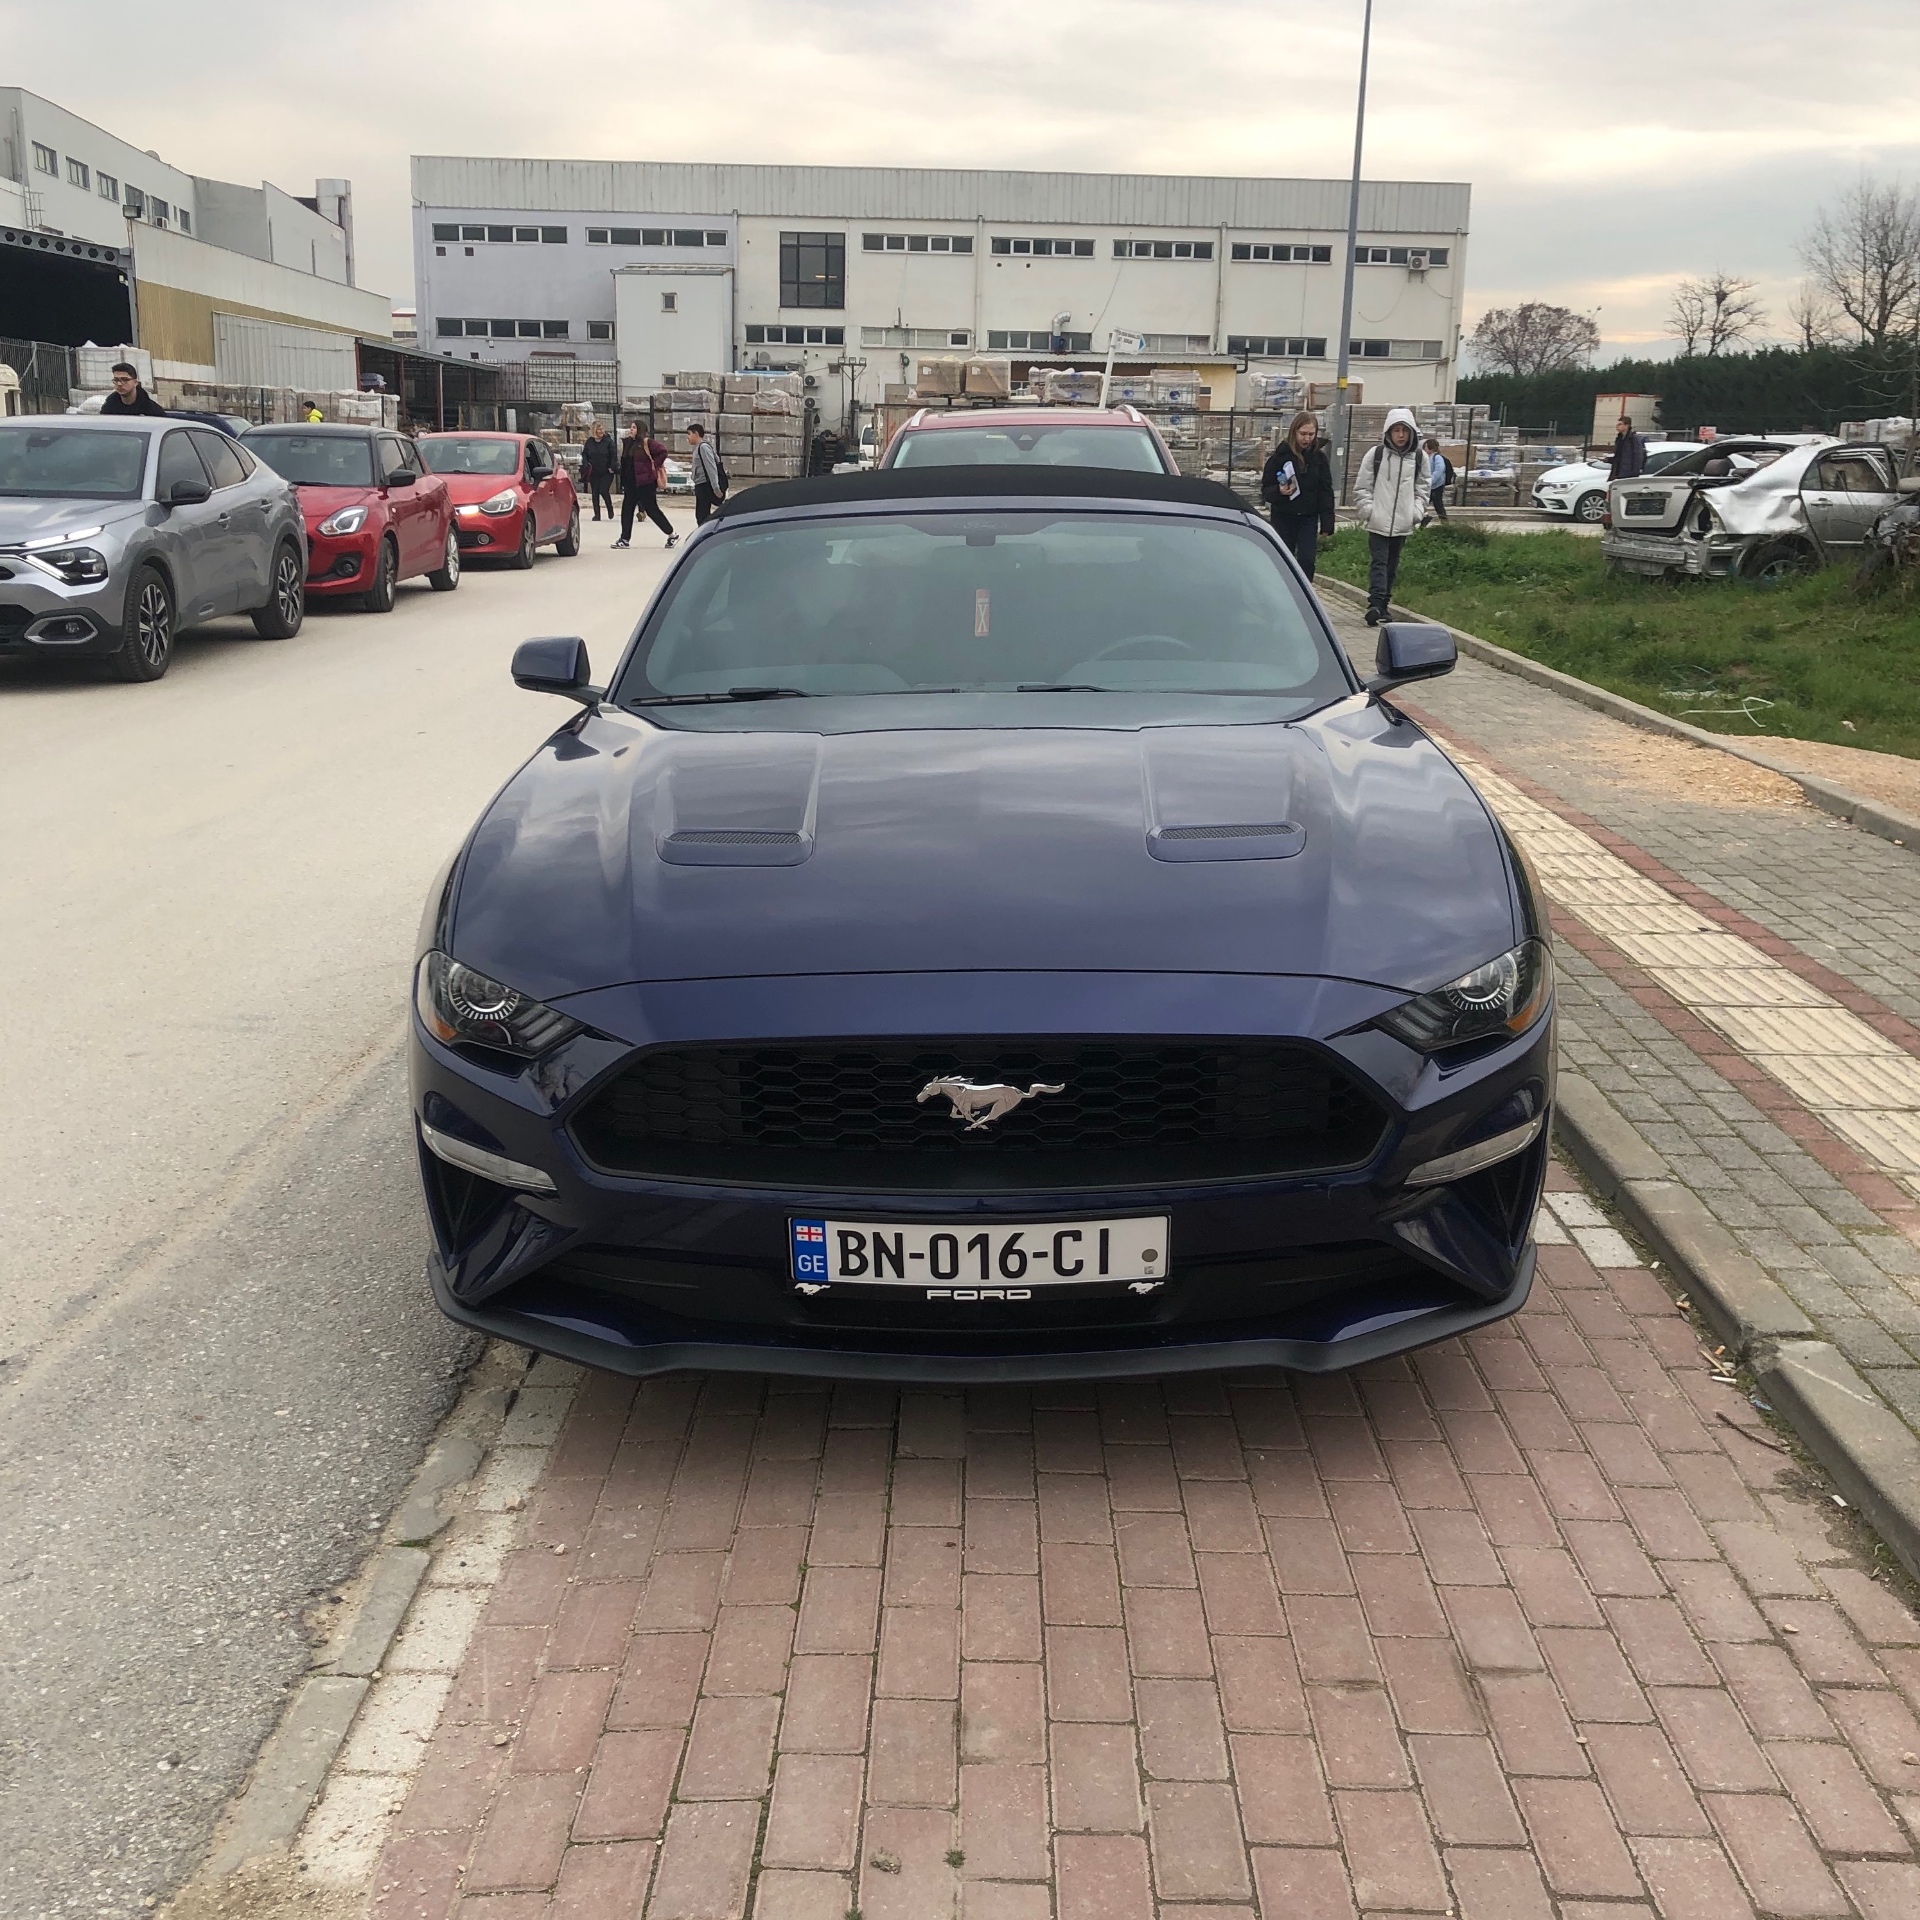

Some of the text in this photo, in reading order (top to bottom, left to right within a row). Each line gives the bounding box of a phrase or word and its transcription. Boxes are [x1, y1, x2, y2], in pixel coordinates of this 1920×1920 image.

[837, 1228, 1109, 1279] BN-016-CI
[798, 1254, 825, 1274] GE
[926, 1289, 1032, 1300] FORD
